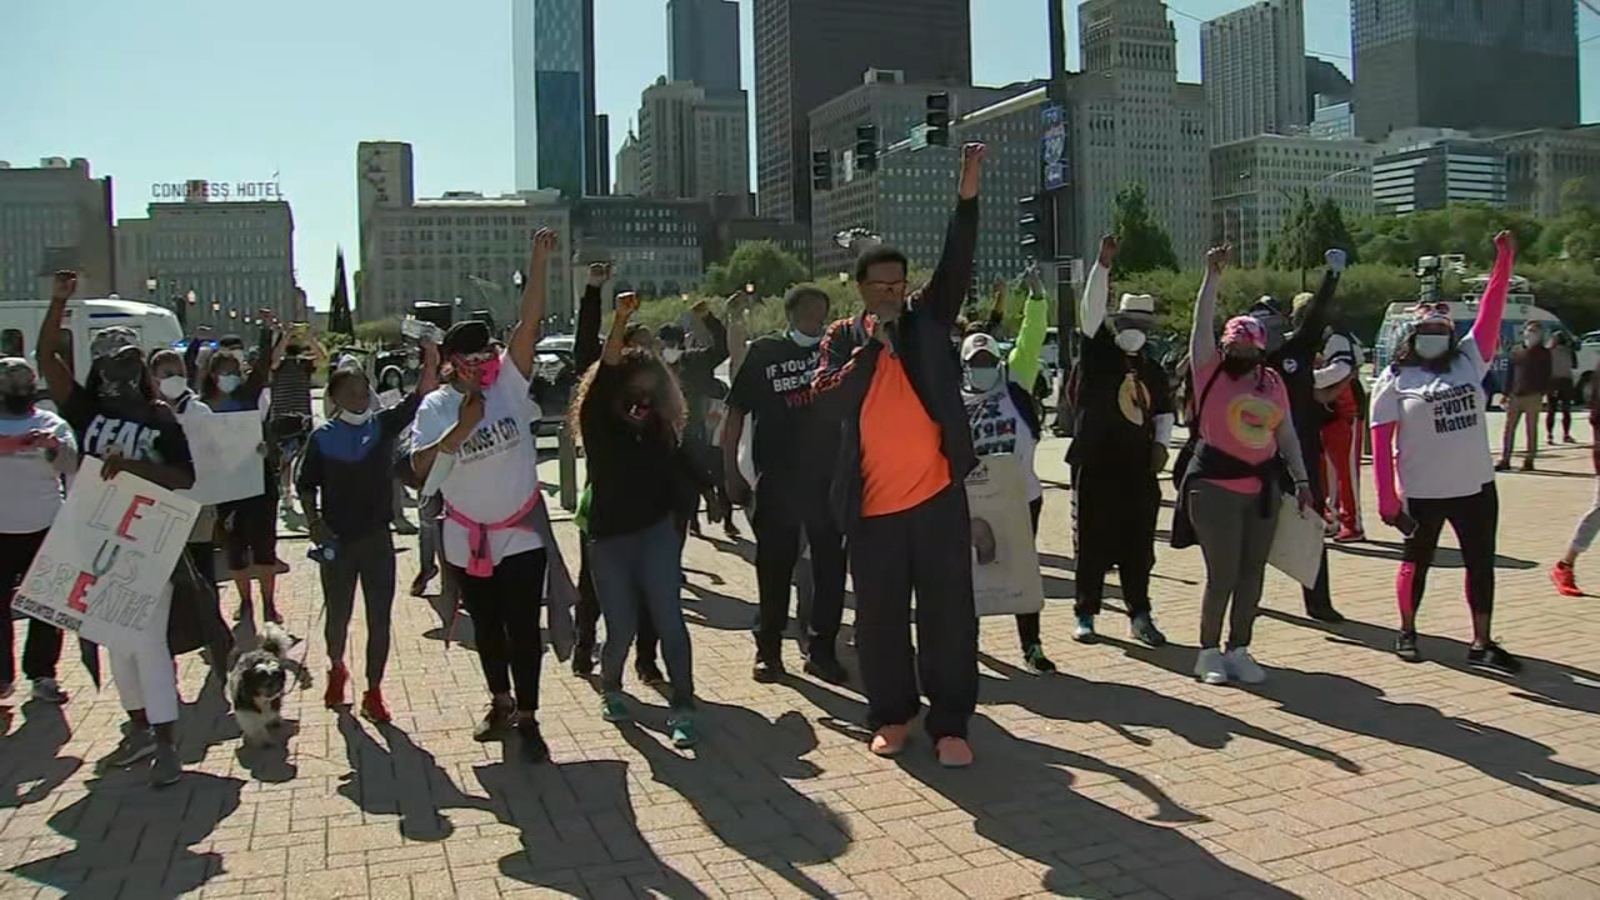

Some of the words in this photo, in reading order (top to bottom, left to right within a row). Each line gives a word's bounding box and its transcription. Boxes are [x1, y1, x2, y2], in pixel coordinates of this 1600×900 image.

[237, 181, 284, 198] HOTEL
[765, 364, 778, 380] IF
[780, 359, 806, 373] YOU
[1433, 394, 1477, 417] #VOTE
[498, 417, 520, 441] CITY
[1433, 413, 1478, 434] Matter
[86, 484, 191, 555] LET
[91, 539, 146, 586] US
[26, 555, 156, 631] BREATHE
